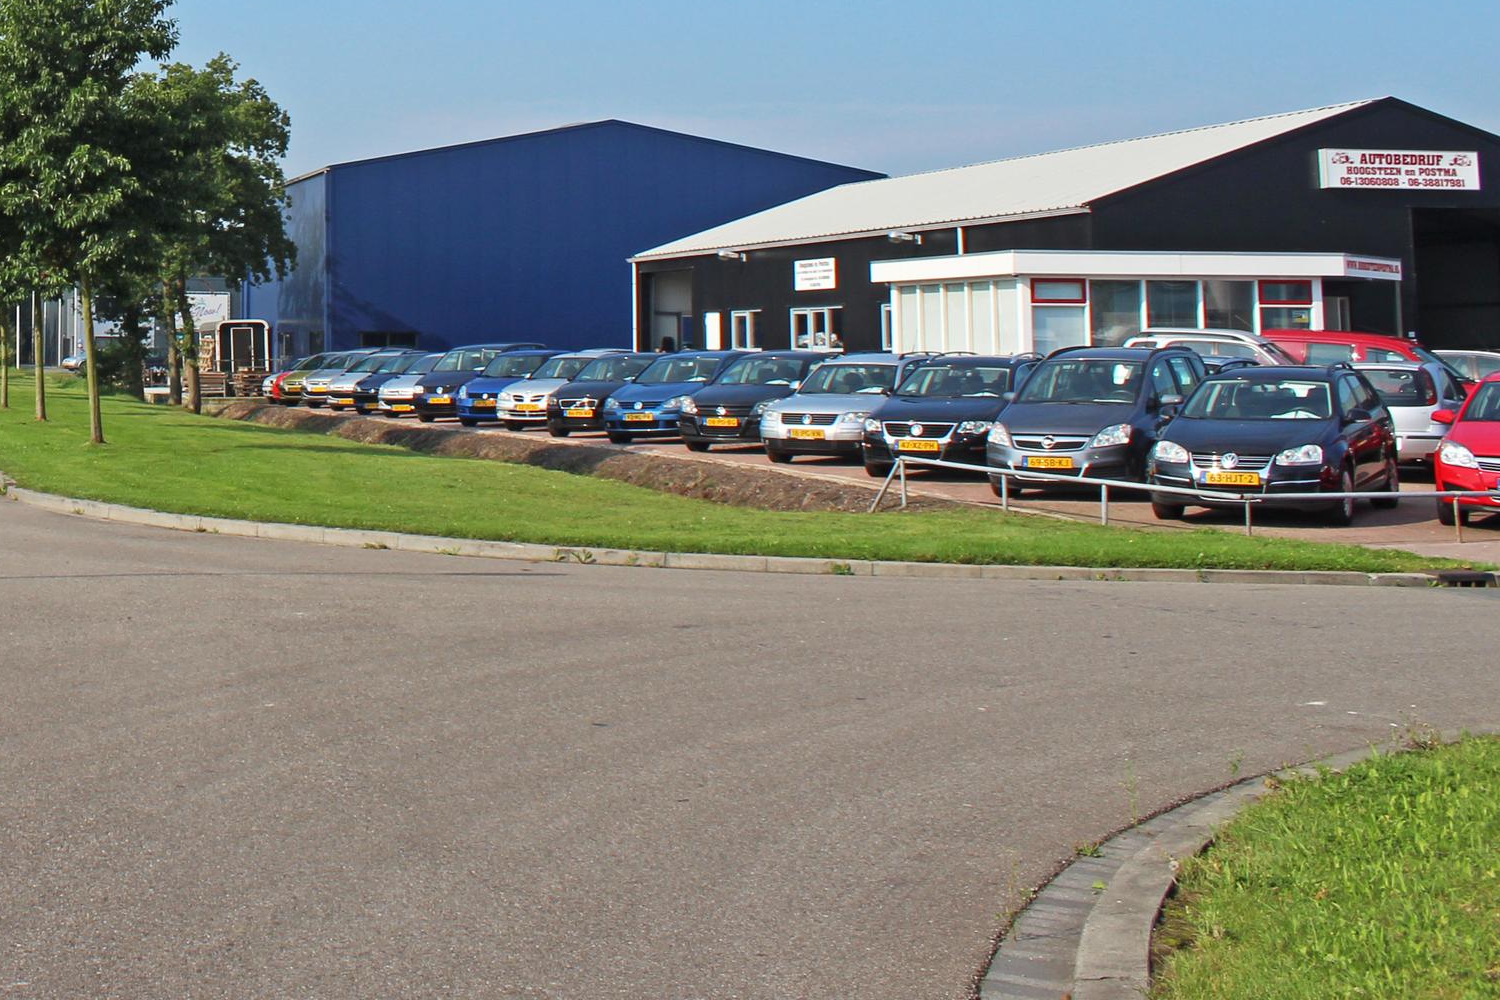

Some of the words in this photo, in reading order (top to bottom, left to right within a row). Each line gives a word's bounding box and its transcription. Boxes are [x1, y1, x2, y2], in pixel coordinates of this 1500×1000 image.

[1360, 153, 1443, 166] AUTOBEDRIJF
[1346, 166, 1402, 176] HOOGSTEEN
[1405, 168, 1416, 176] en
[1418, 167, 1457, 177] POSTMA
[1340, 177, 1399, 187] 06-13060808
[1210, 474, 1254, 483] 63-HJT-2
